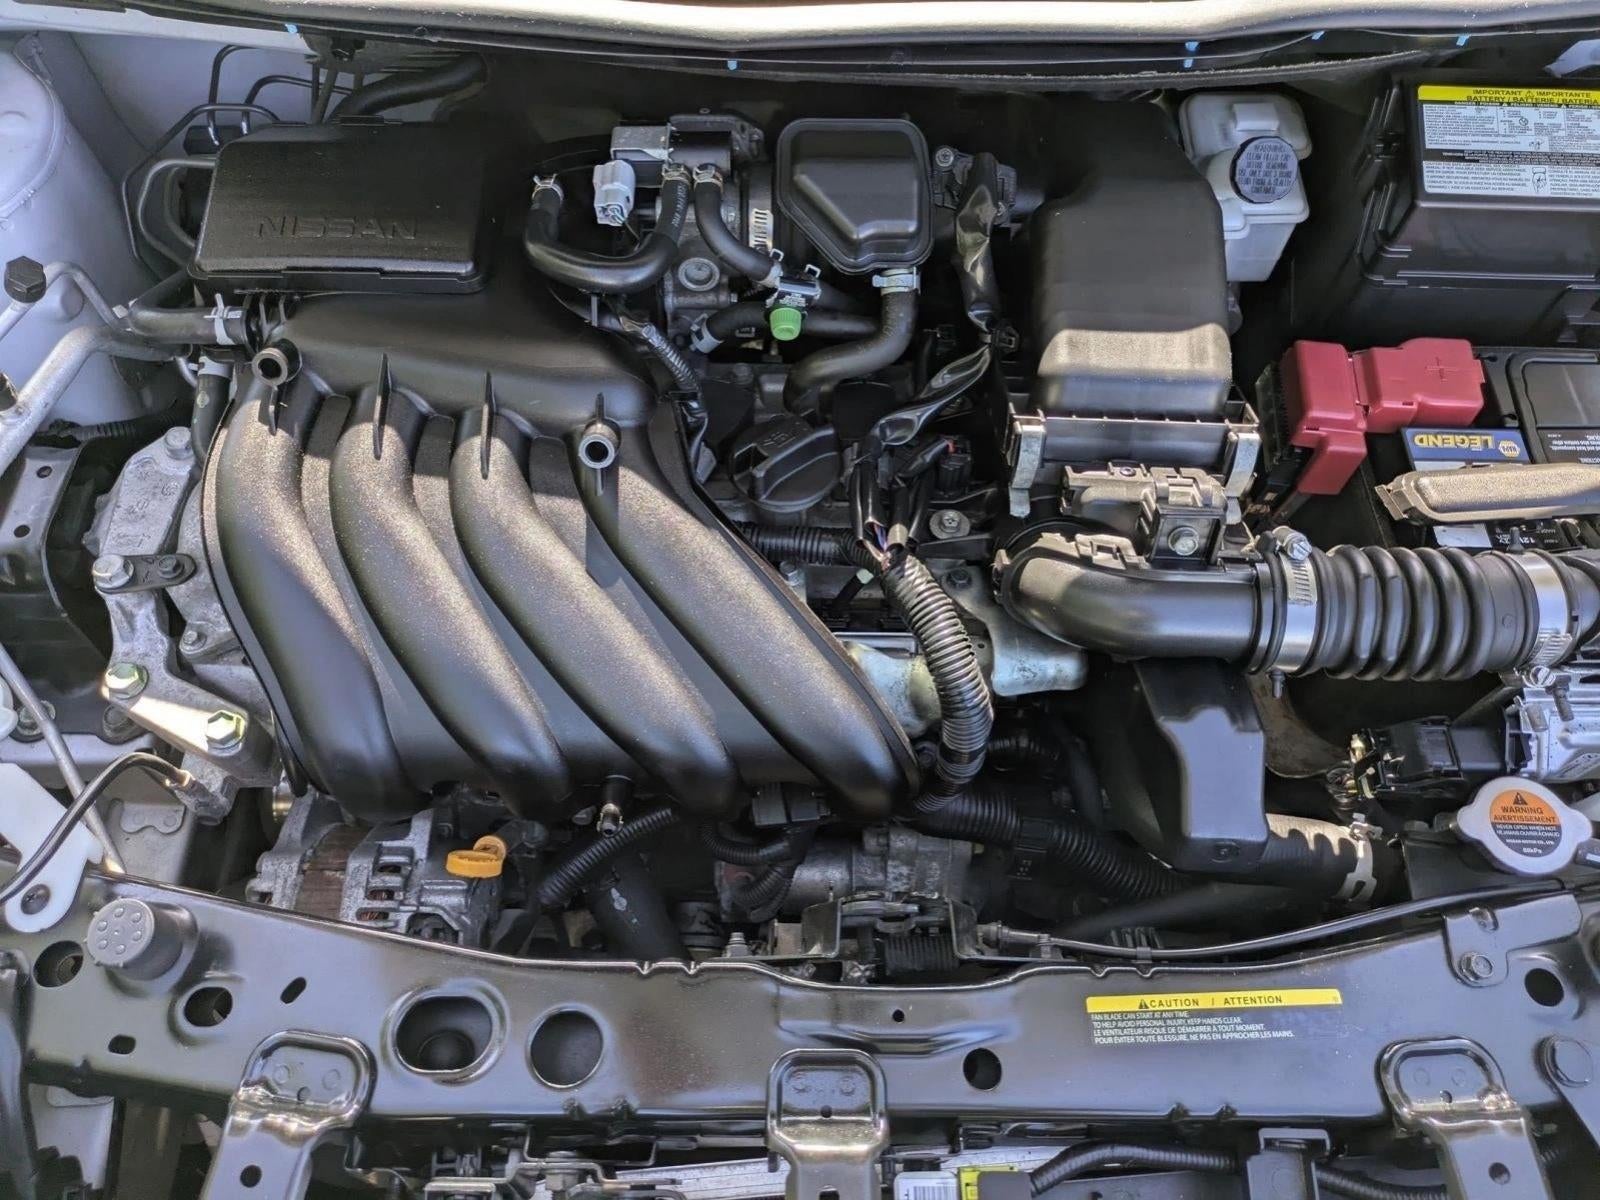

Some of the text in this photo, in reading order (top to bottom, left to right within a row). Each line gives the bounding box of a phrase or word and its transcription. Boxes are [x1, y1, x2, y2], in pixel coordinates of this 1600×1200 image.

[1473, 89, 1591, 98] IMPORTANT IMPORTANTE
[257, 215, 418, 240] NISSAN
[1413, 434, 1494, 450] LEGEND
[1501, 445, 1518, 454] NAPA
[1501, 806, 1544, 814] WARNING
[1493, 815, 1555, 823] AVERTISSEMENT
[1149, 998, 1199, 1008] CAUTION
[1223, 995, 1283, 1005] ATTENTION
[1136, 1019, 1164, 1027] PERSONAL
[1102, 1028, 1143, 1036] VENTILATEUR
[1143, 1027, 1167, 1035] RISQUE
[1095, 1036, 1114, 1044] POUR
[1135, 1035, 1157, 1043] TOUTE
[1189, 1033, 1199, 1041] NE
[1221, 1031, 1259, 1040] APPROCHER
